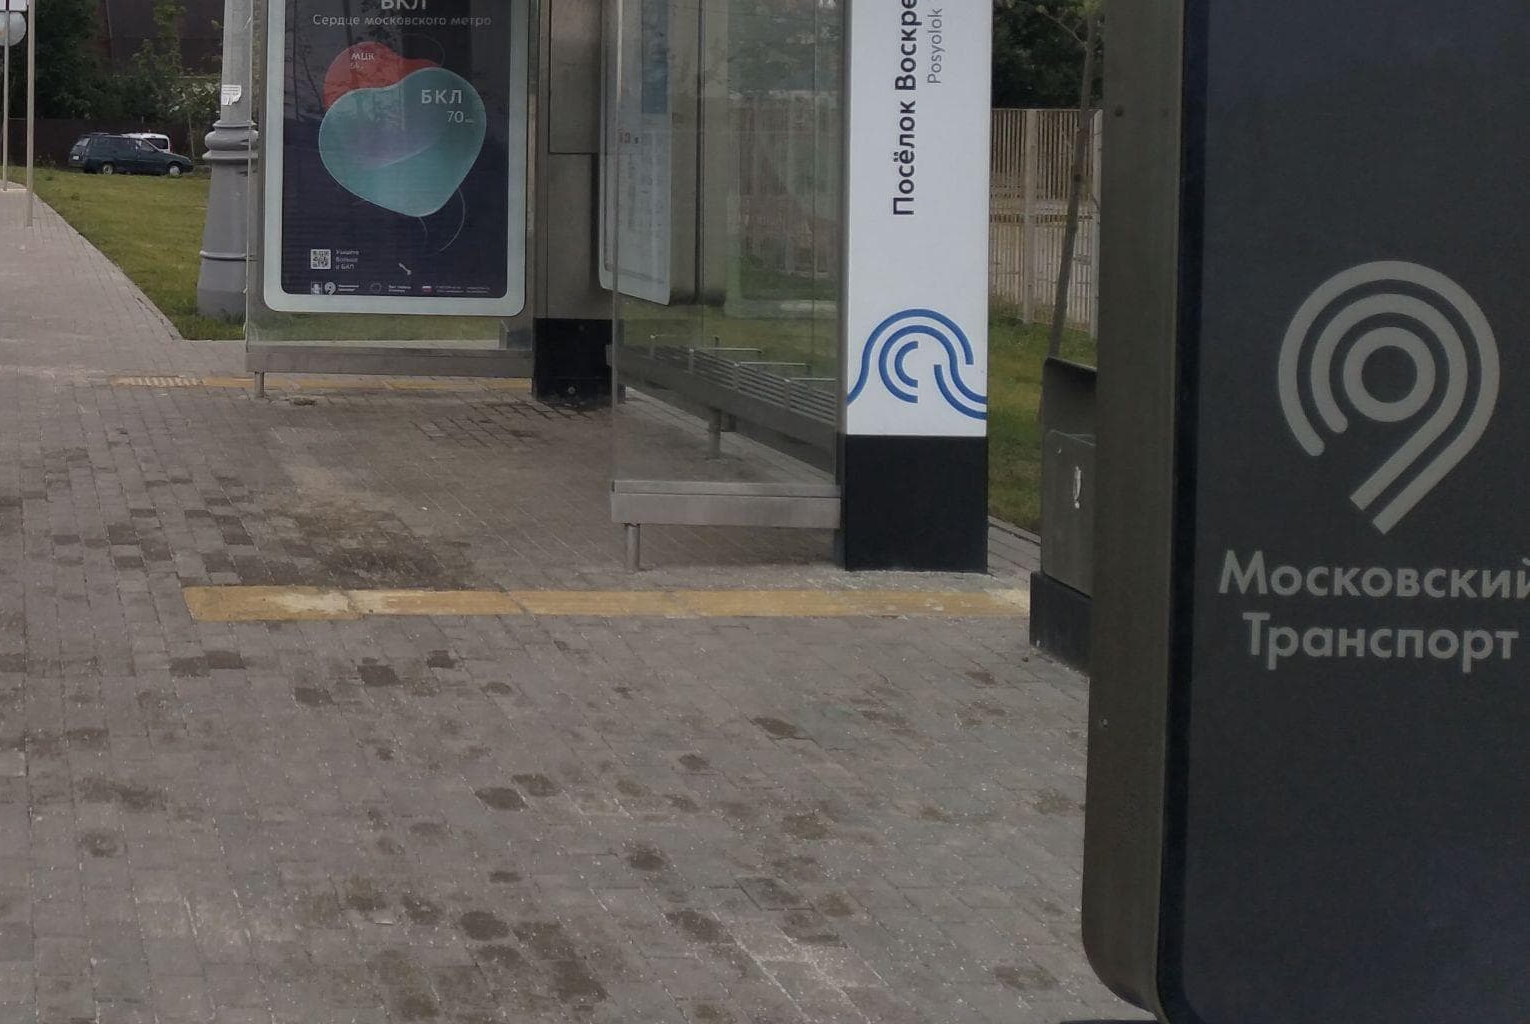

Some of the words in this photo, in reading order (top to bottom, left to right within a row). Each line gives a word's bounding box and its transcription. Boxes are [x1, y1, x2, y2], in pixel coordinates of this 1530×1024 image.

[312, 14, 360, 26] Сердце
[364, 16, 447, 26] московского
[450, 16, 492, 27] метро
[927, 7, 946, 84] Posyolok
[421, 89, 463, 104] БКЛ
[446, 110, 464, 123] 70
[892, 100, 916, 216] Посёлок
[1242, 611, 1519, 674] Транспорт
